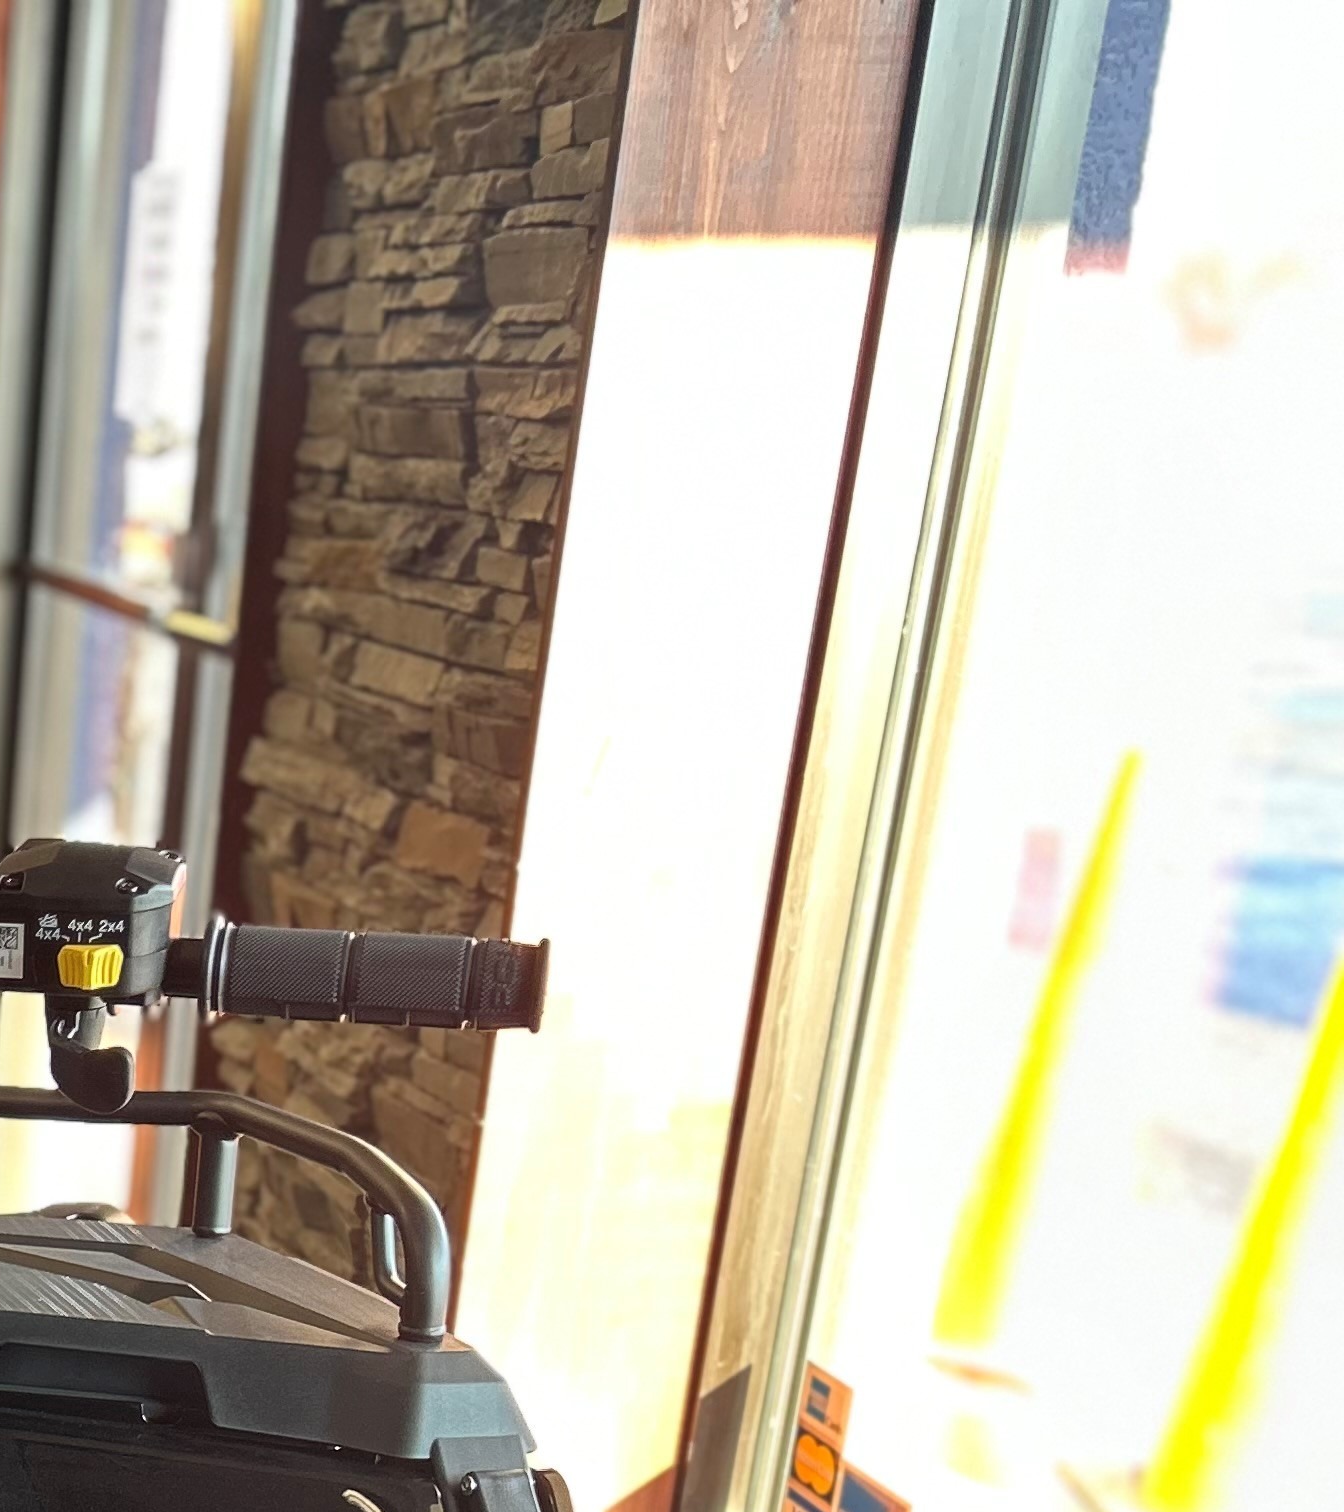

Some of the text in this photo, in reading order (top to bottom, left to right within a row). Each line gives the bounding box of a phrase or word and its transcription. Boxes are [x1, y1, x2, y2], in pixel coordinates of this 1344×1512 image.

[67, 919, 93, 932] 4x4
[98, 920, 125, 933] 2x4
[35, 928, 61, 941] 4x4
